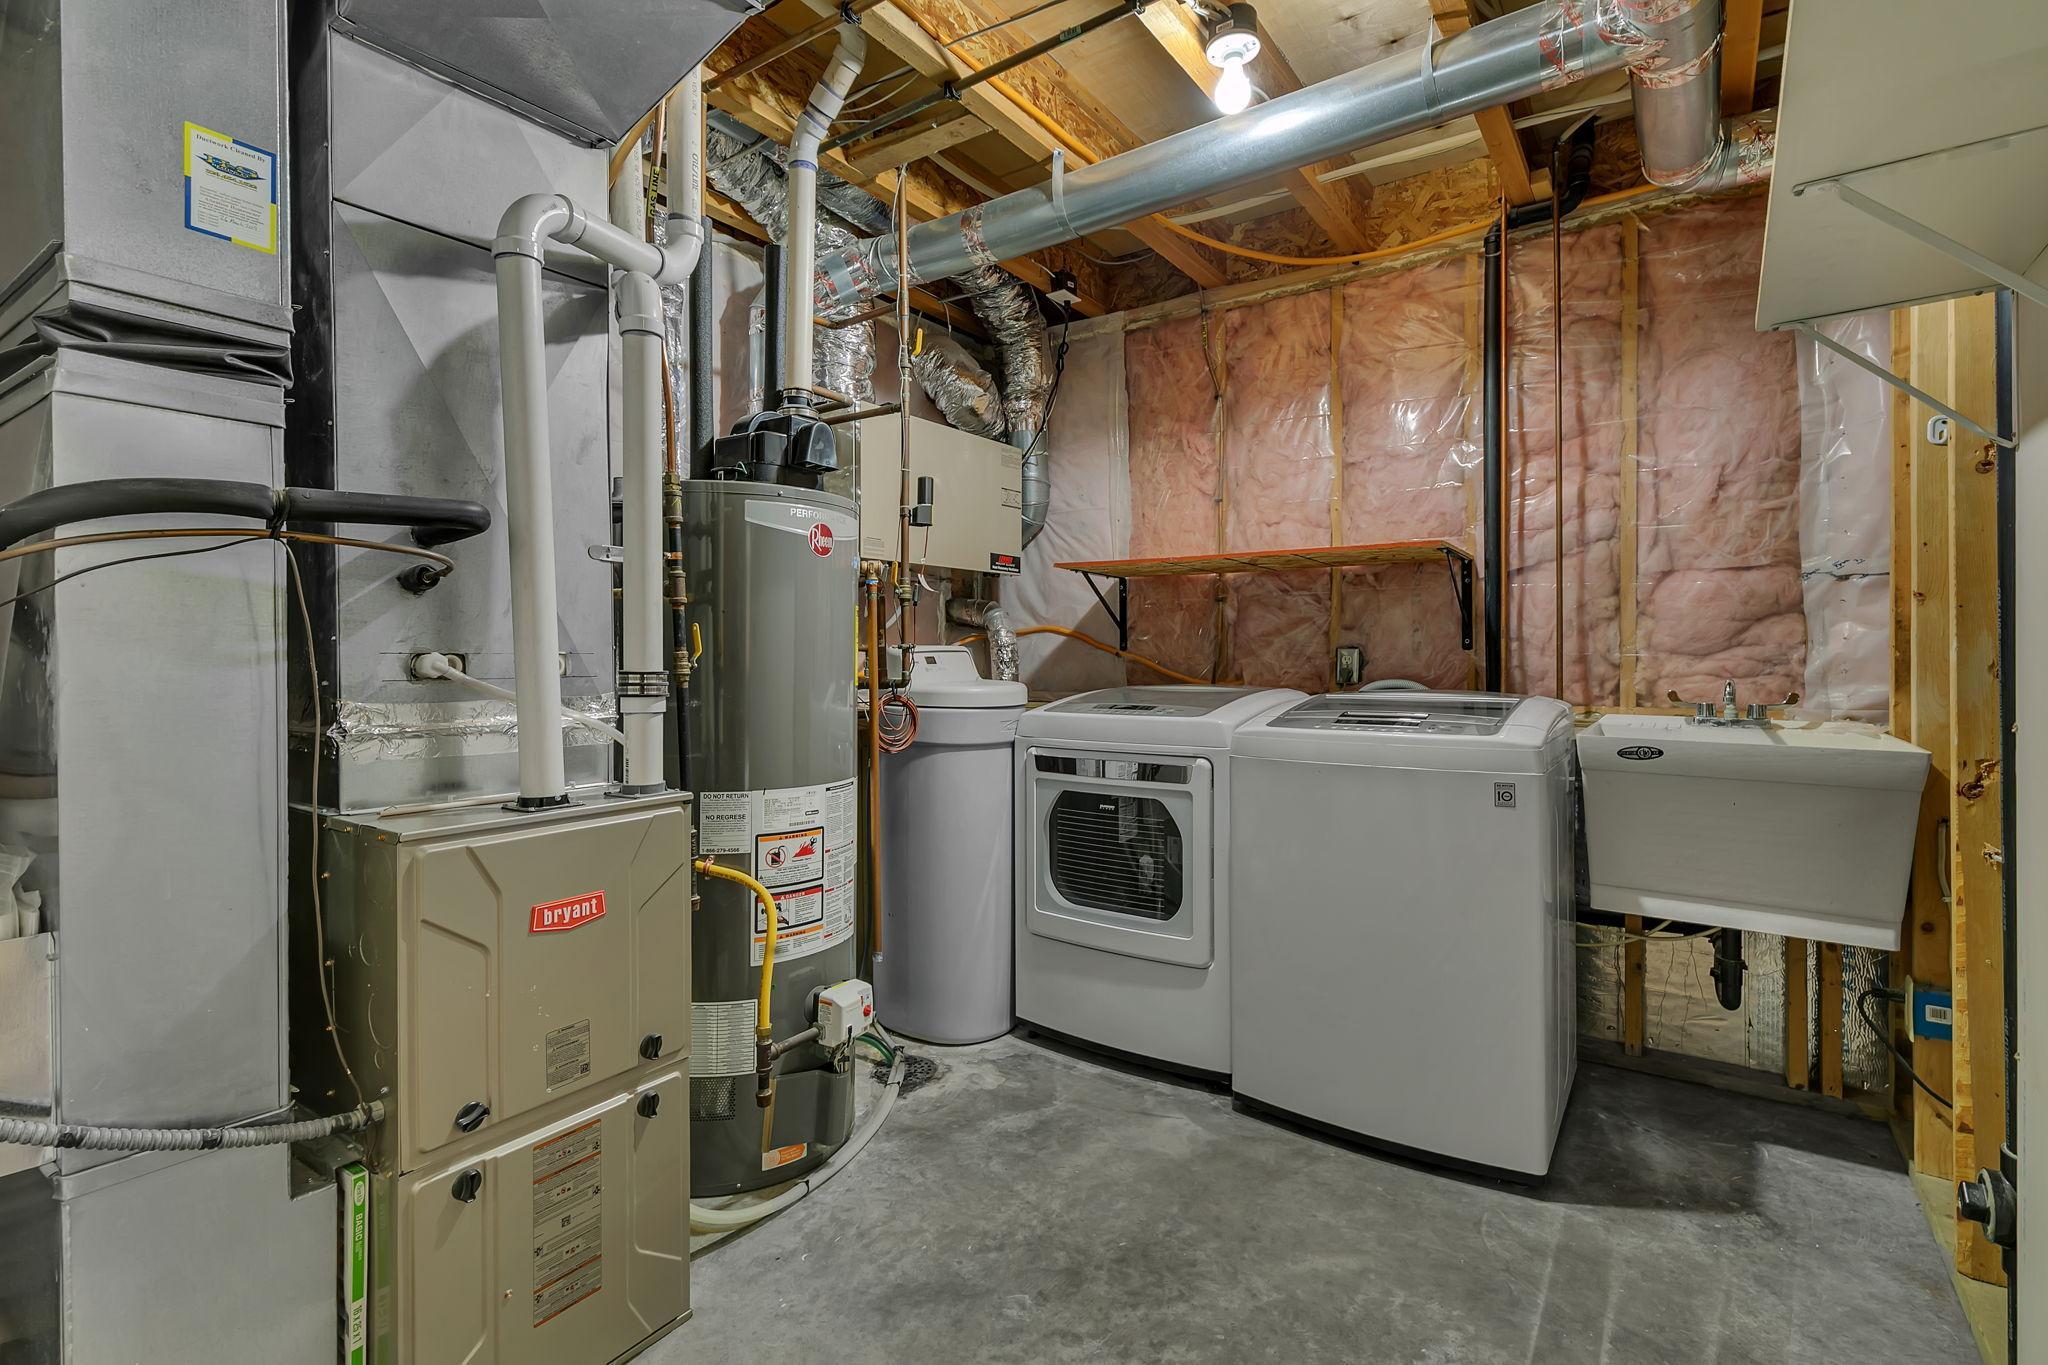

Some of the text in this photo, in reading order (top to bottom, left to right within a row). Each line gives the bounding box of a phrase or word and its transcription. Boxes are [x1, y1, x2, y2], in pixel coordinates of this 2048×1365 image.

[196, 134, 228, 149] Ductwork
[230, 146, 256, 159] Cleaned
[651, 168, 660, 193] LINE
[811, 524, 833, 551] Rheem
[786, 891, 806, 899] DANGER
[543, 898, 598, 926] bryant
[355, 1213, 363, 1242] BASIC
[353, 1305, 363, 1316] 16
